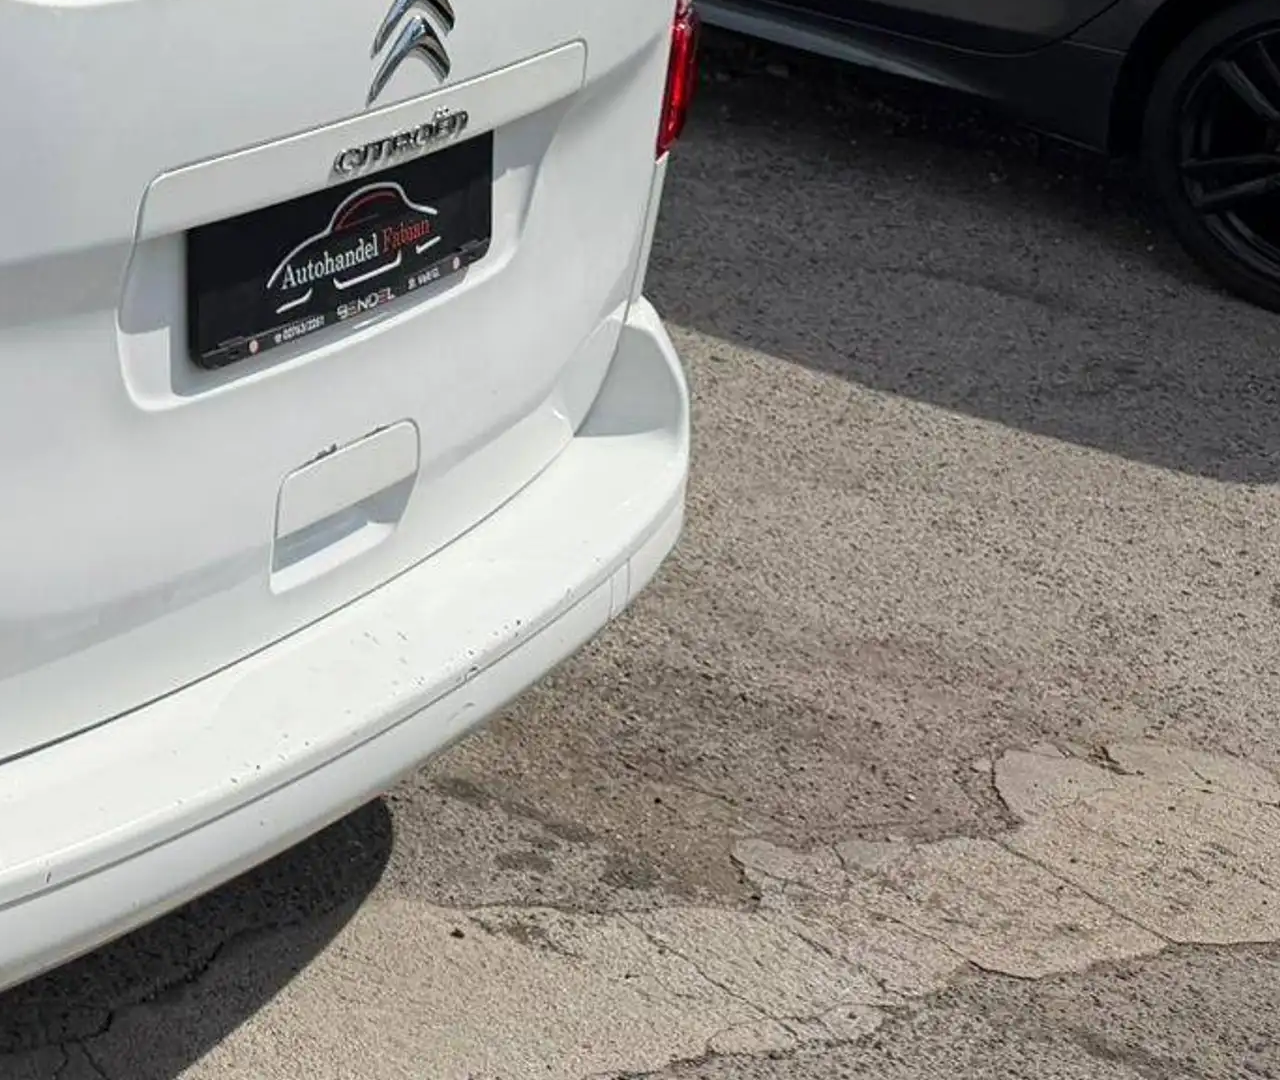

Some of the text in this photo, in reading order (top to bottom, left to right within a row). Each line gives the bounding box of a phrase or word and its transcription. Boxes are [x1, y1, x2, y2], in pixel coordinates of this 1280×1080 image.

[332, 106, 470, 174] CITROËN
[281, 232, 379, 291] Autohandel
[381, 218, 432, 255] Fabian
